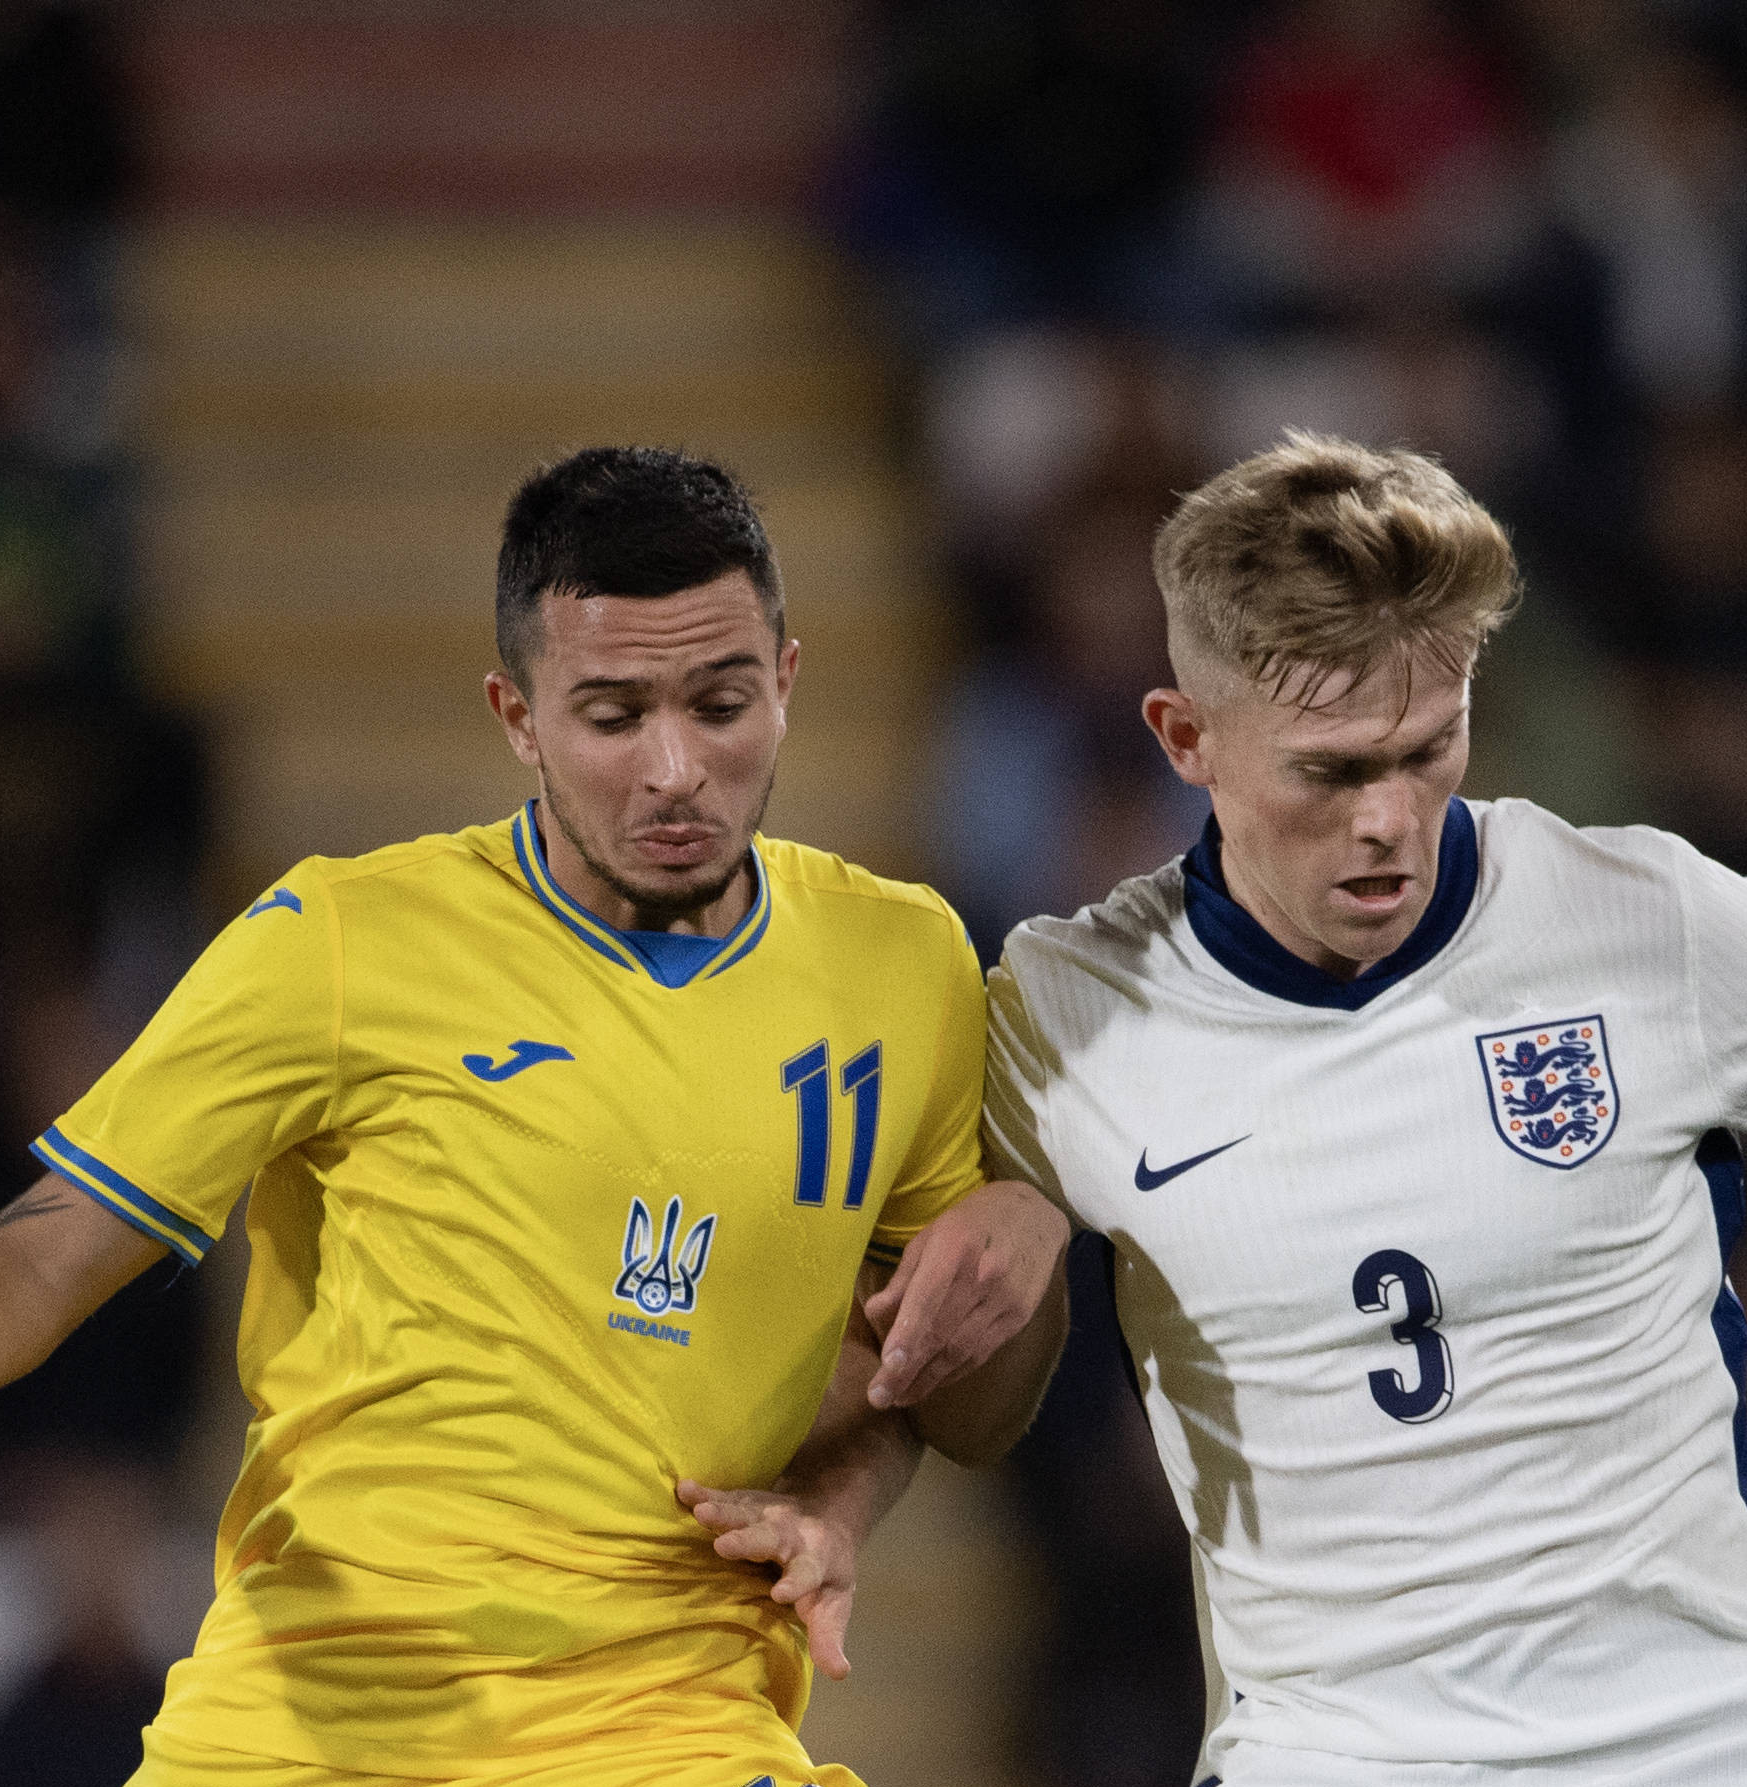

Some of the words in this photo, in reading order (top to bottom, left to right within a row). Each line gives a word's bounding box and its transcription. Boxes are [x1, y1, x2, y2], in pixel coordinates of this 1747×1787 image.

[780, 1037, 883, 1211] 11
[607, 1312, 691, 1347] UKRAINE
[1352, 1248, 1454, 1424] 3
